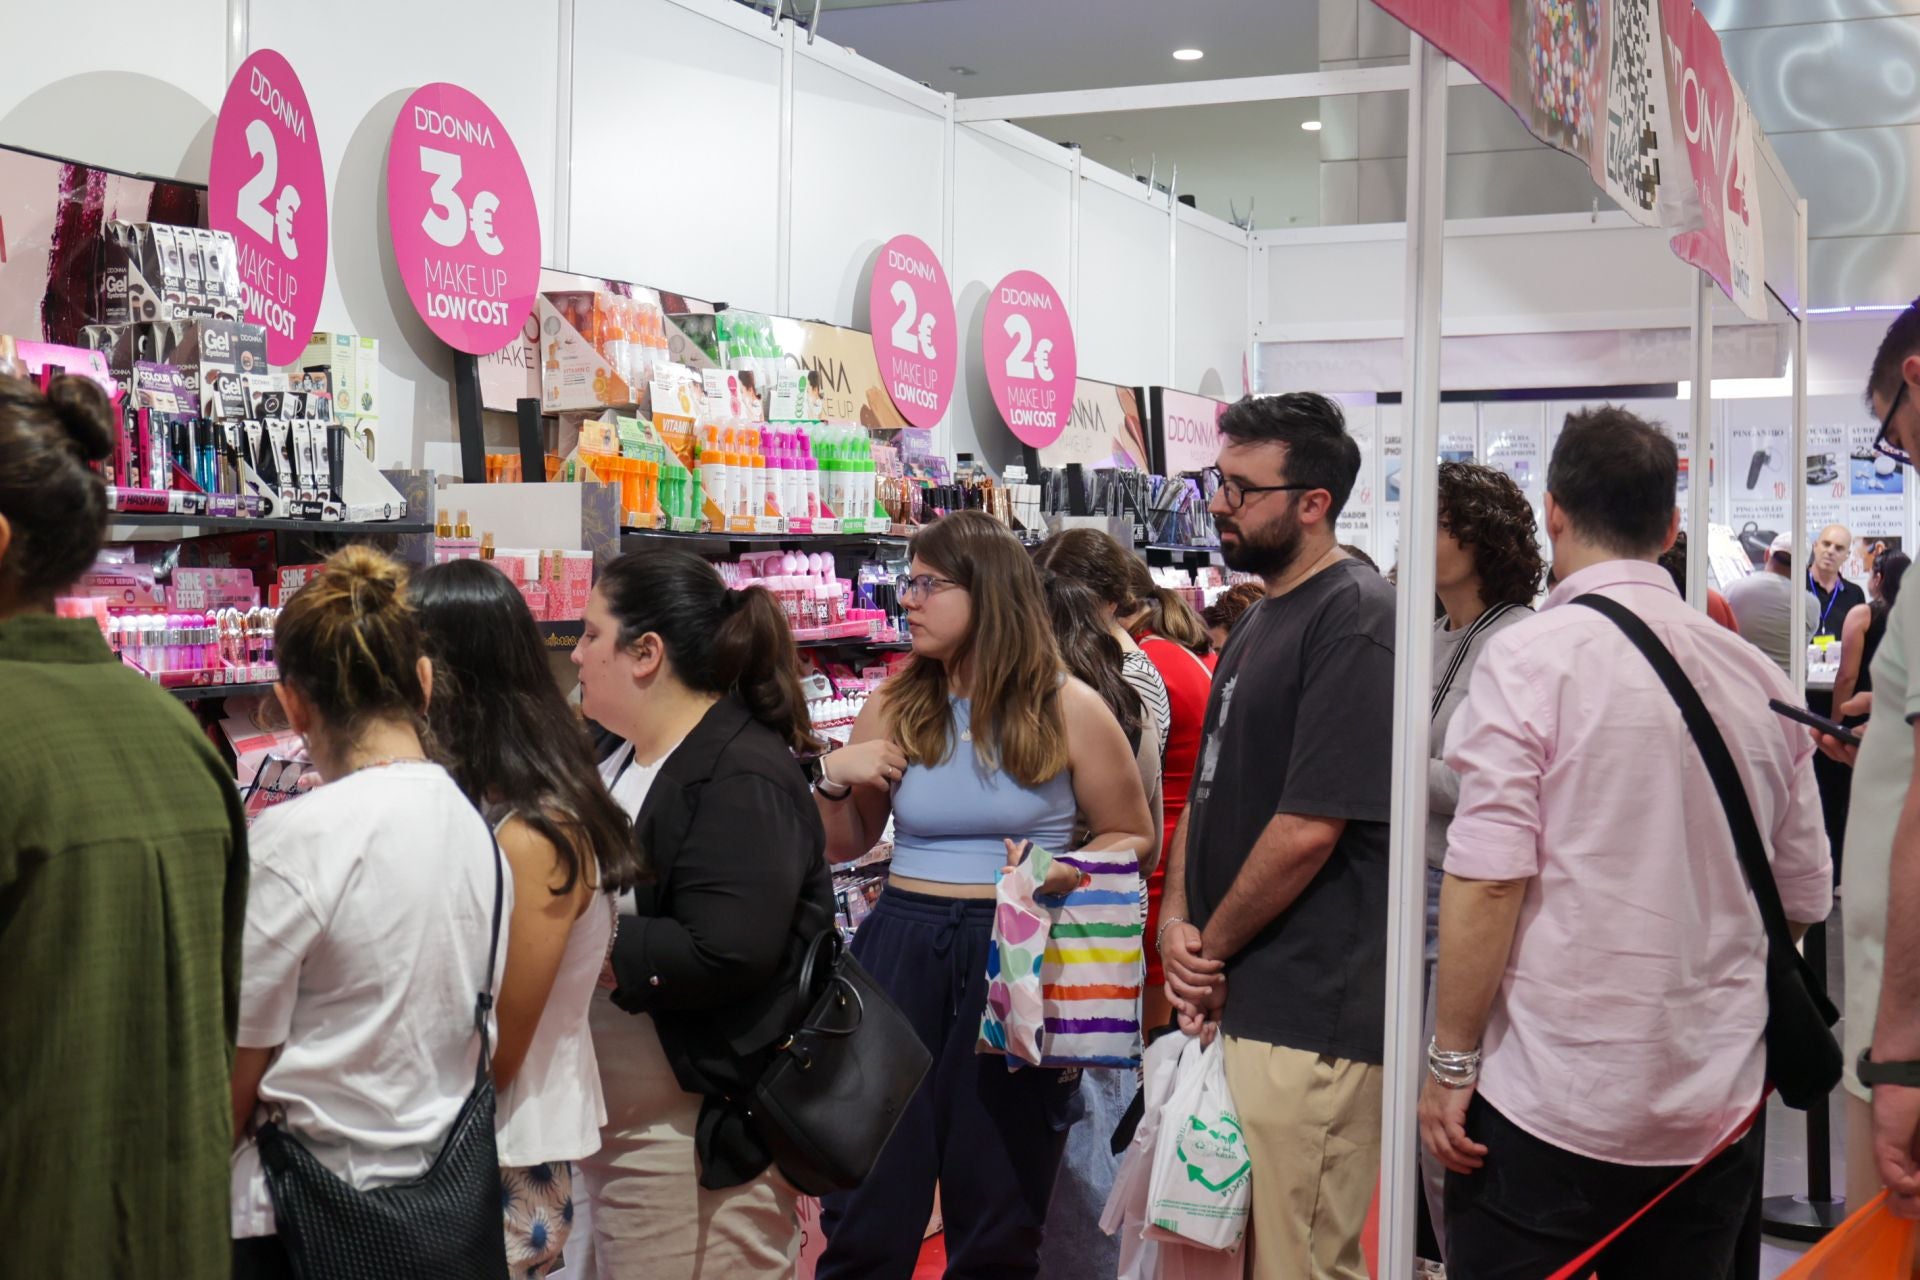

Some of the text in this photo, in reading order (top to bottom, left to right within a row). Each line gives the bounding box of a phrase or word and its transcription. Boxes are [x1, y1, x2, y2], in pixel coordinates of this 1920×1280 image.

[237, 119, 302, 260] 2€
[420, 145, 504, 256] 3€
[164, 276, 179, 287] Gel
[235, 235, 298, 308] MAKE UP
[424, 257, 508, 298] MAKE UP
[106, 275, 127, 293] Gel
[184, 279, 199, 291] Gel
[205, 281, 220, 292] Gel
[174, 306, 189, 318] Gel
[890, 280, 938, 360] 2€
[204, 329, 230, 352] Gel
[1003, 313, 1055, 382] 2€
[892, 357, 938, 390] MAKE UP
[219, 376, 241, 396] Gel
[1007, 386, 1056, 410] MAKE UP
[290, 503, 303, 515] Gel
[176, 572, 202, 590] SHINE
[281, 568, 306, 588] SHINE
